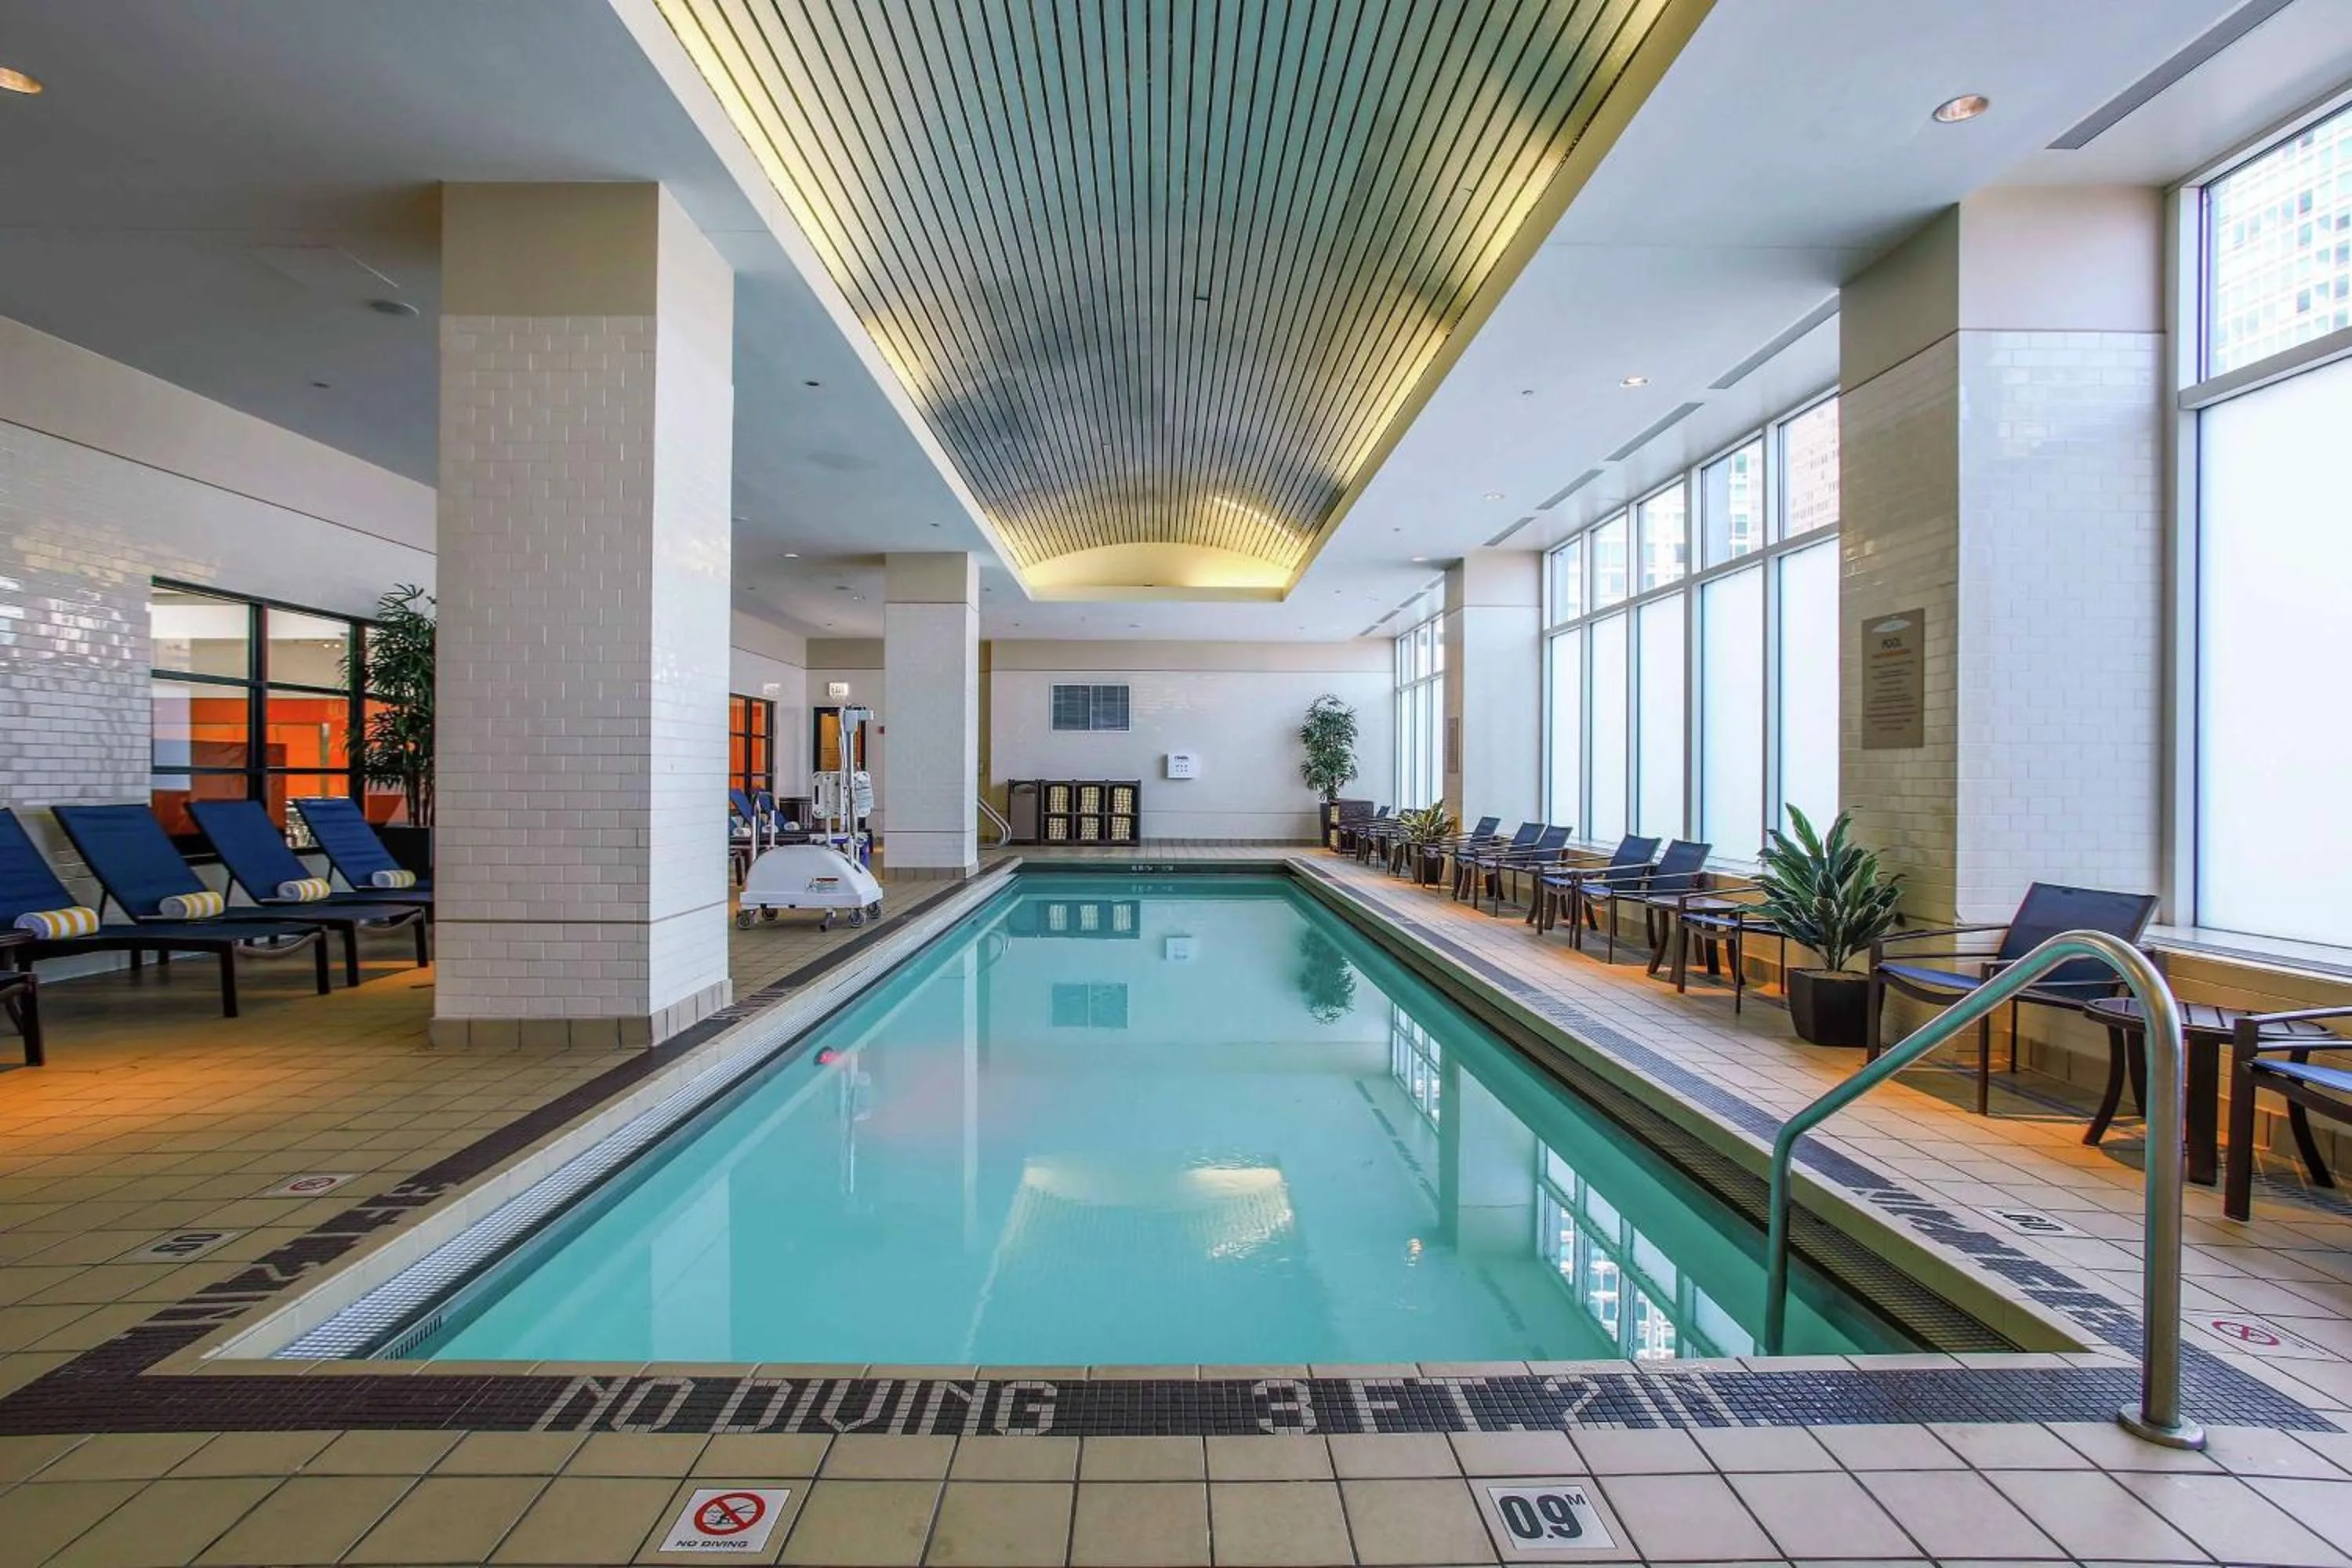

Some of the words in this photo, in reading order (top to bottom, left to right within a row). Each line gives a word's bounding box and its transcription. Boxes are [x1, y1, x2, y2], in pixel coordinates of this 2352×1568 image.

[528, 1377, 695, 1434] NO
[712, 1377, 1058, 1437] DIVING
[1254, 1378, 1317, 1436] 3
[1544, 1374, 1630, 1431] 2
